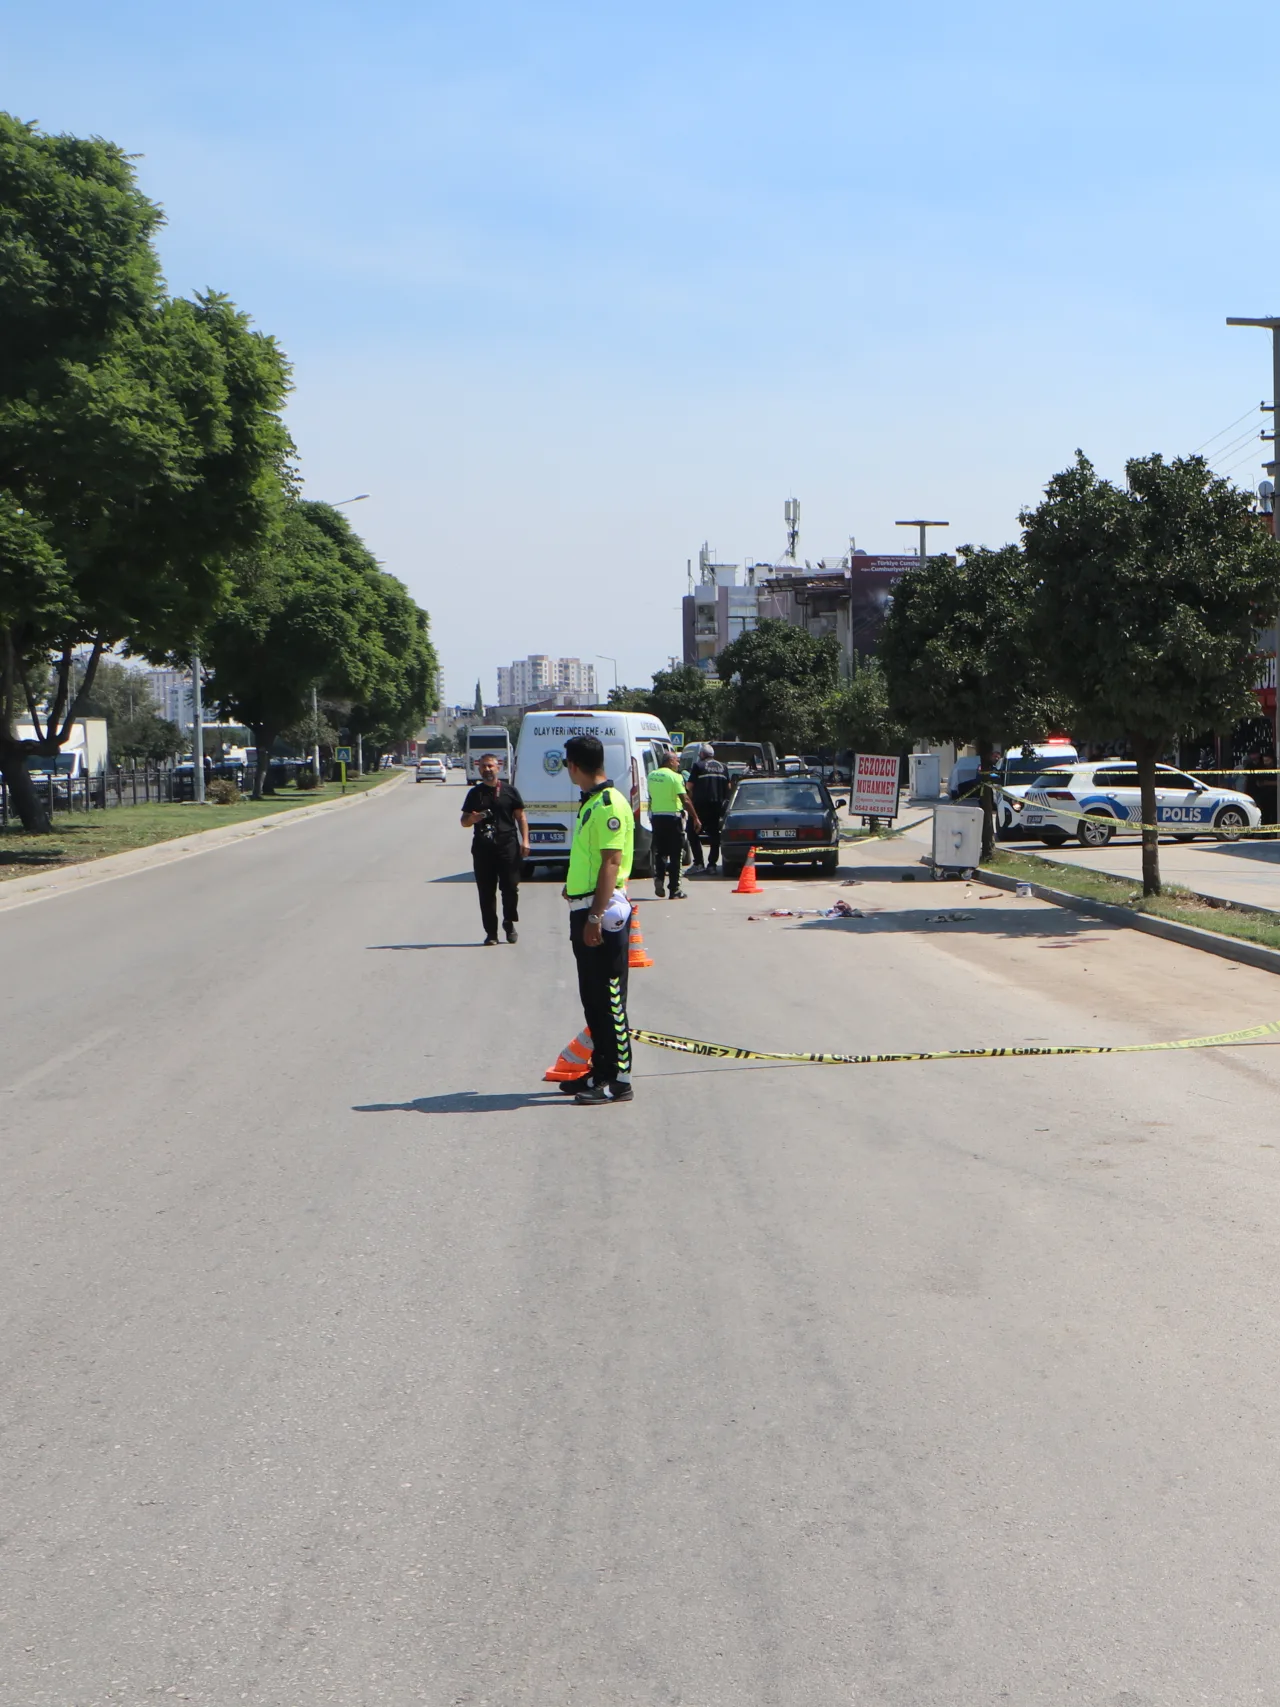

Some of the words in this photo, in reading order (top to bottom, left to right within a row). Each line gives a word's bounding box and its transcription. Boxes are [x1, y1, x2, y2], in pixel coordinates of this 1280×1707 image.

[533, 727, 549, 736] OLAY
[858, 757, 897, 777] EGZOZCU
[856, 779, 895, 795] MUHAMMET
[761, 830, 768, 838] 01
